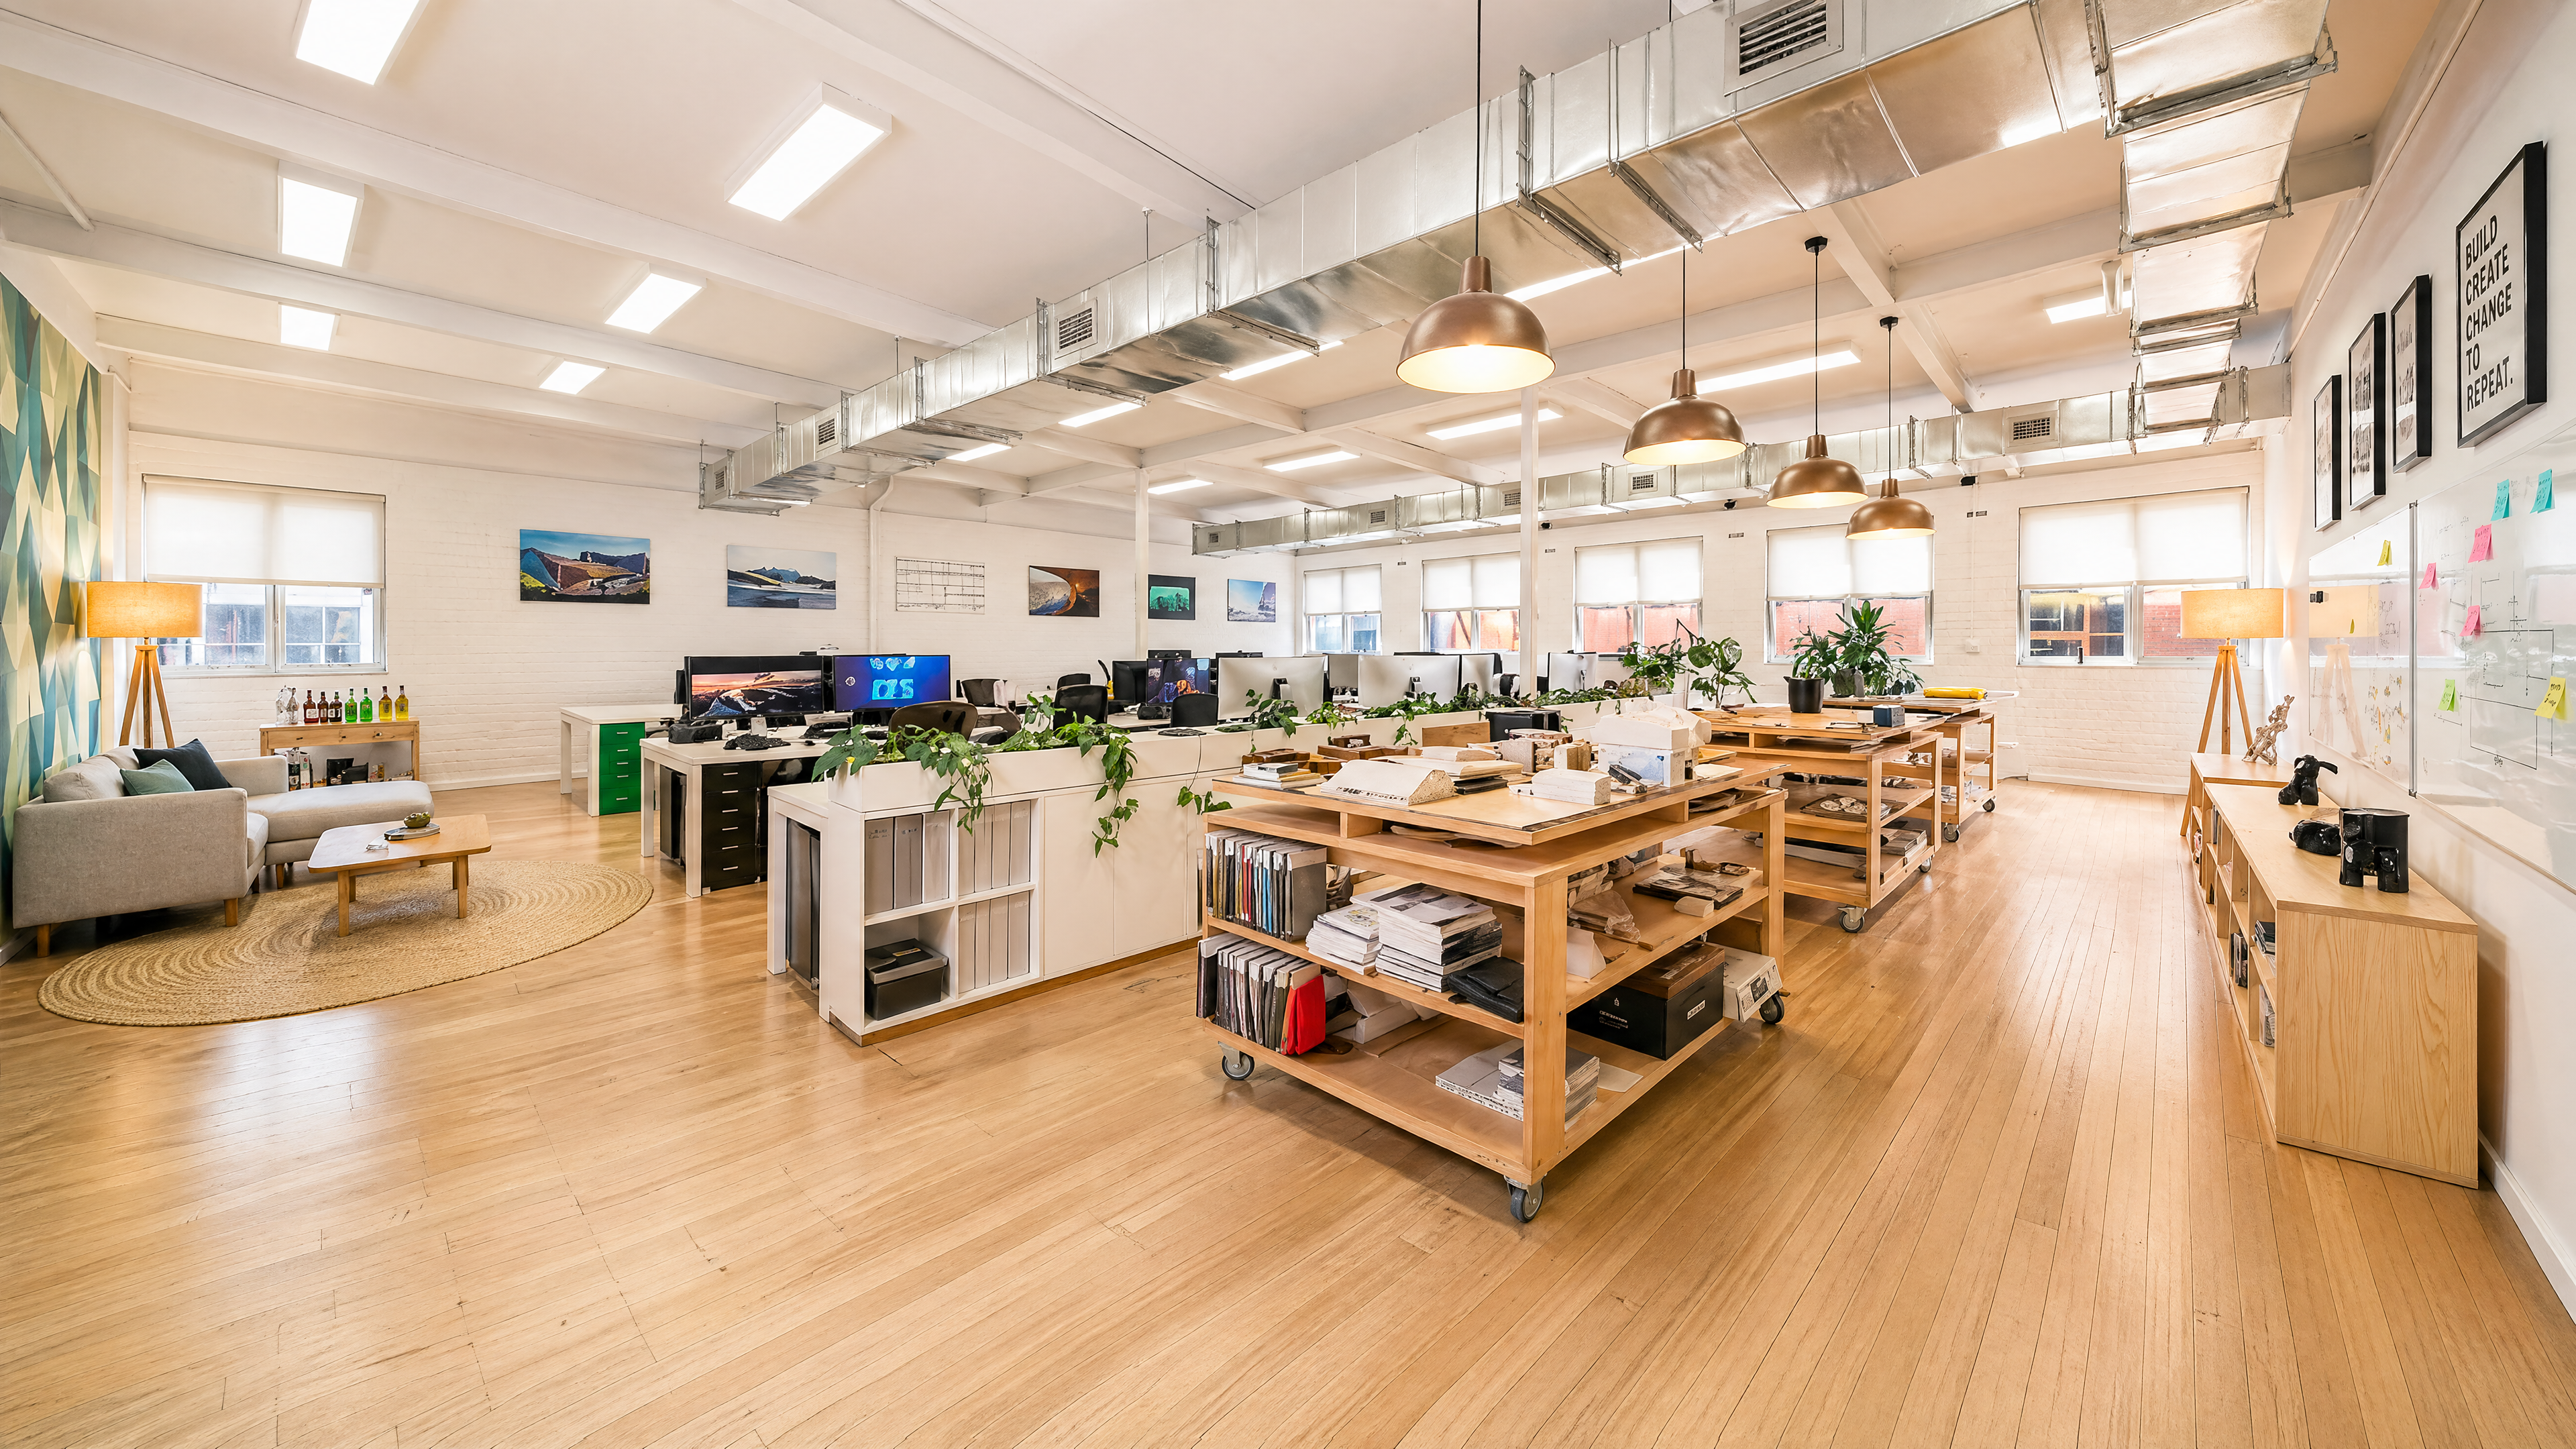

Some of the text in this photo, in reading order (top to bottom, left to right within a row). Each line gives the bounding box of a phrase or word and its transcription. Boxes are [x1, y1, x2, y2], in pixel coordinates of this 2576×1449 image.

[2465, 215, 2498, 271] BUILD
[2465, 243, 2510, 306] CREATE
[2465, 282, 2512, 342] CHANGE
[2465, 343, 2481, 376] TO
[2466, 356, 2514, 413] REPEAT.
